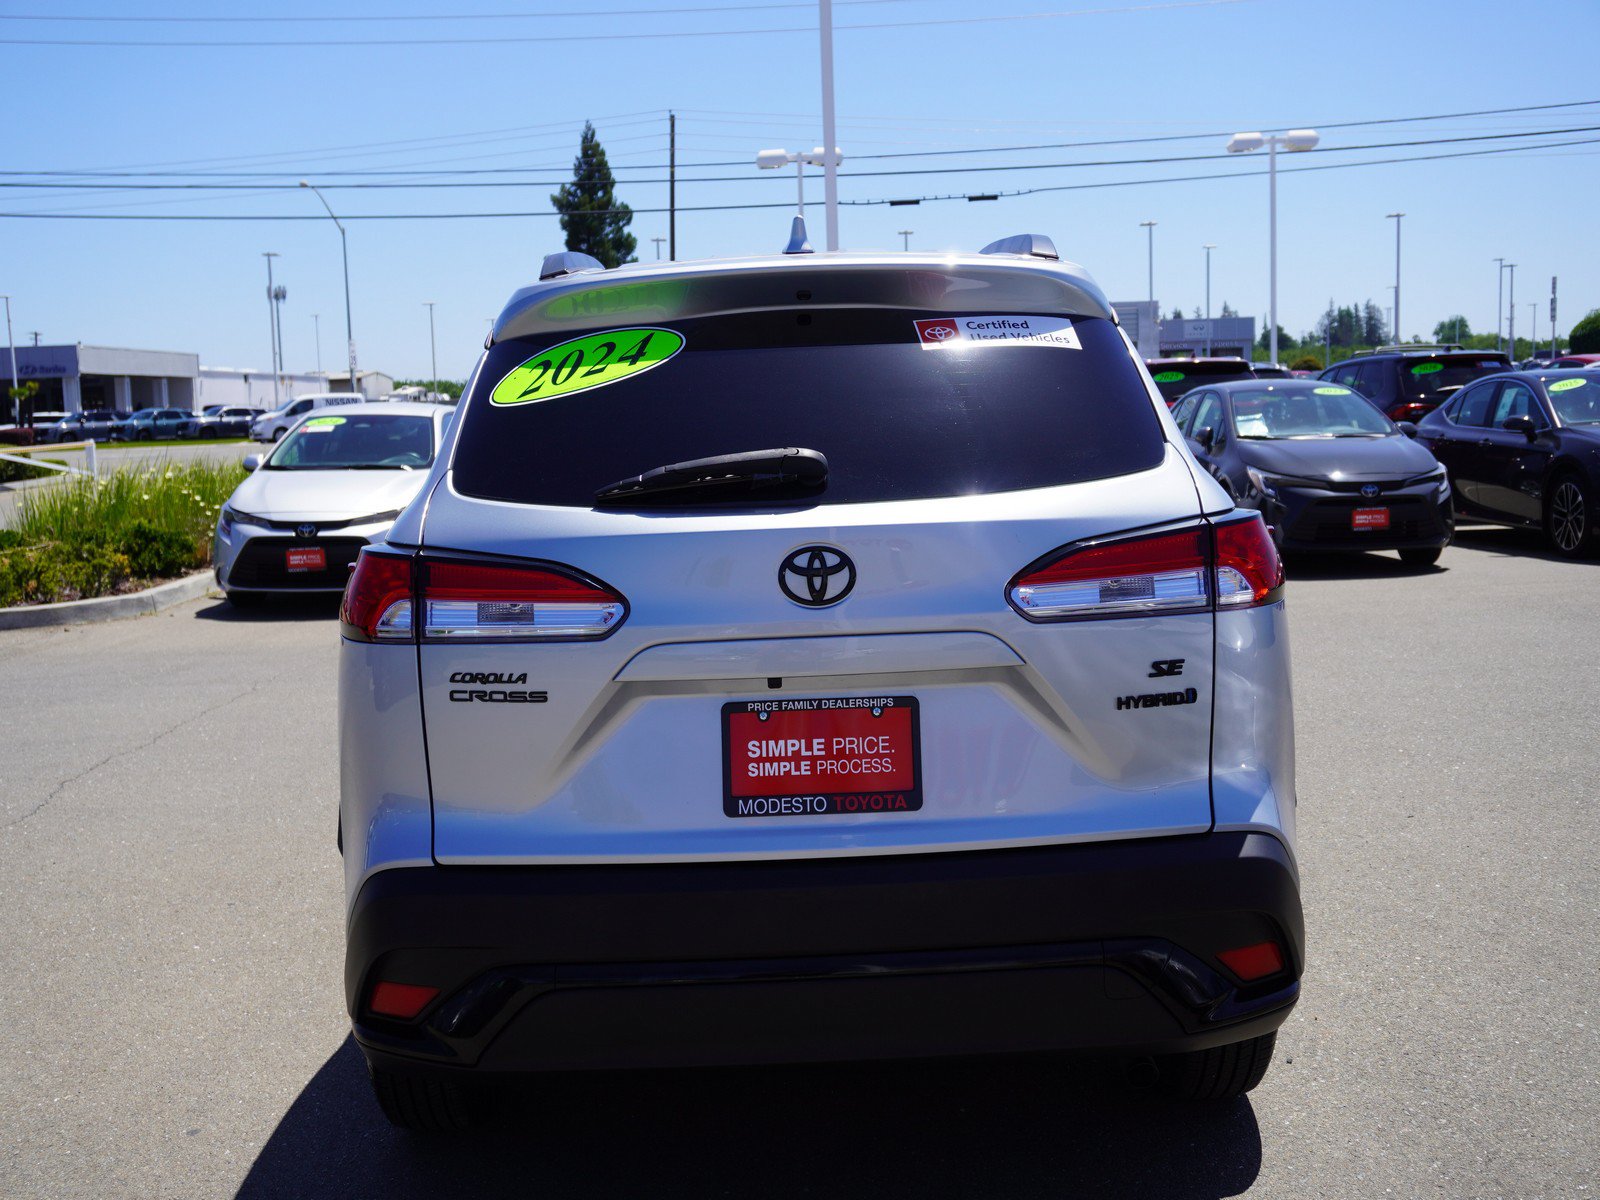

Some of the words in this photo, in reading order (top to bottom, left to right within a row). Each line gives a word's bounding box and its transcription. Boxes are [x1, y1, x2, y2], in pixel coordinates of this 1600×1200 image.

[966, 320, 1030, 330] Certified
[970, 332, 1007, 342] Used
[1010, 332, 1071, 344] Vehicles
[517, 332, 655, 400] 2024
[326, 397, 358, 406] NISSAN
[1148, 658, 1186, 678] SE
[449, 672, 528, 685] COROLLA
[449, 690, 548, 703] CROSS
[747, 701, 779, 712] PRICE
[782, 699, 819, 710] FAMILY
[822, 697, 894, 709] DEALERSHIPS
[1116, 691, 1186, 710] HYBRID
[747, 738, 826, 758] SIMPLE
[833, 736, 895, 755] PRICE.
[747, 761, 812, 777] SIMPLE
[817, 758, 896, 775] PROCESS.
[738, 796, 827, 815] MODESTO
[834, 794, 907, 812] TOYOTA
